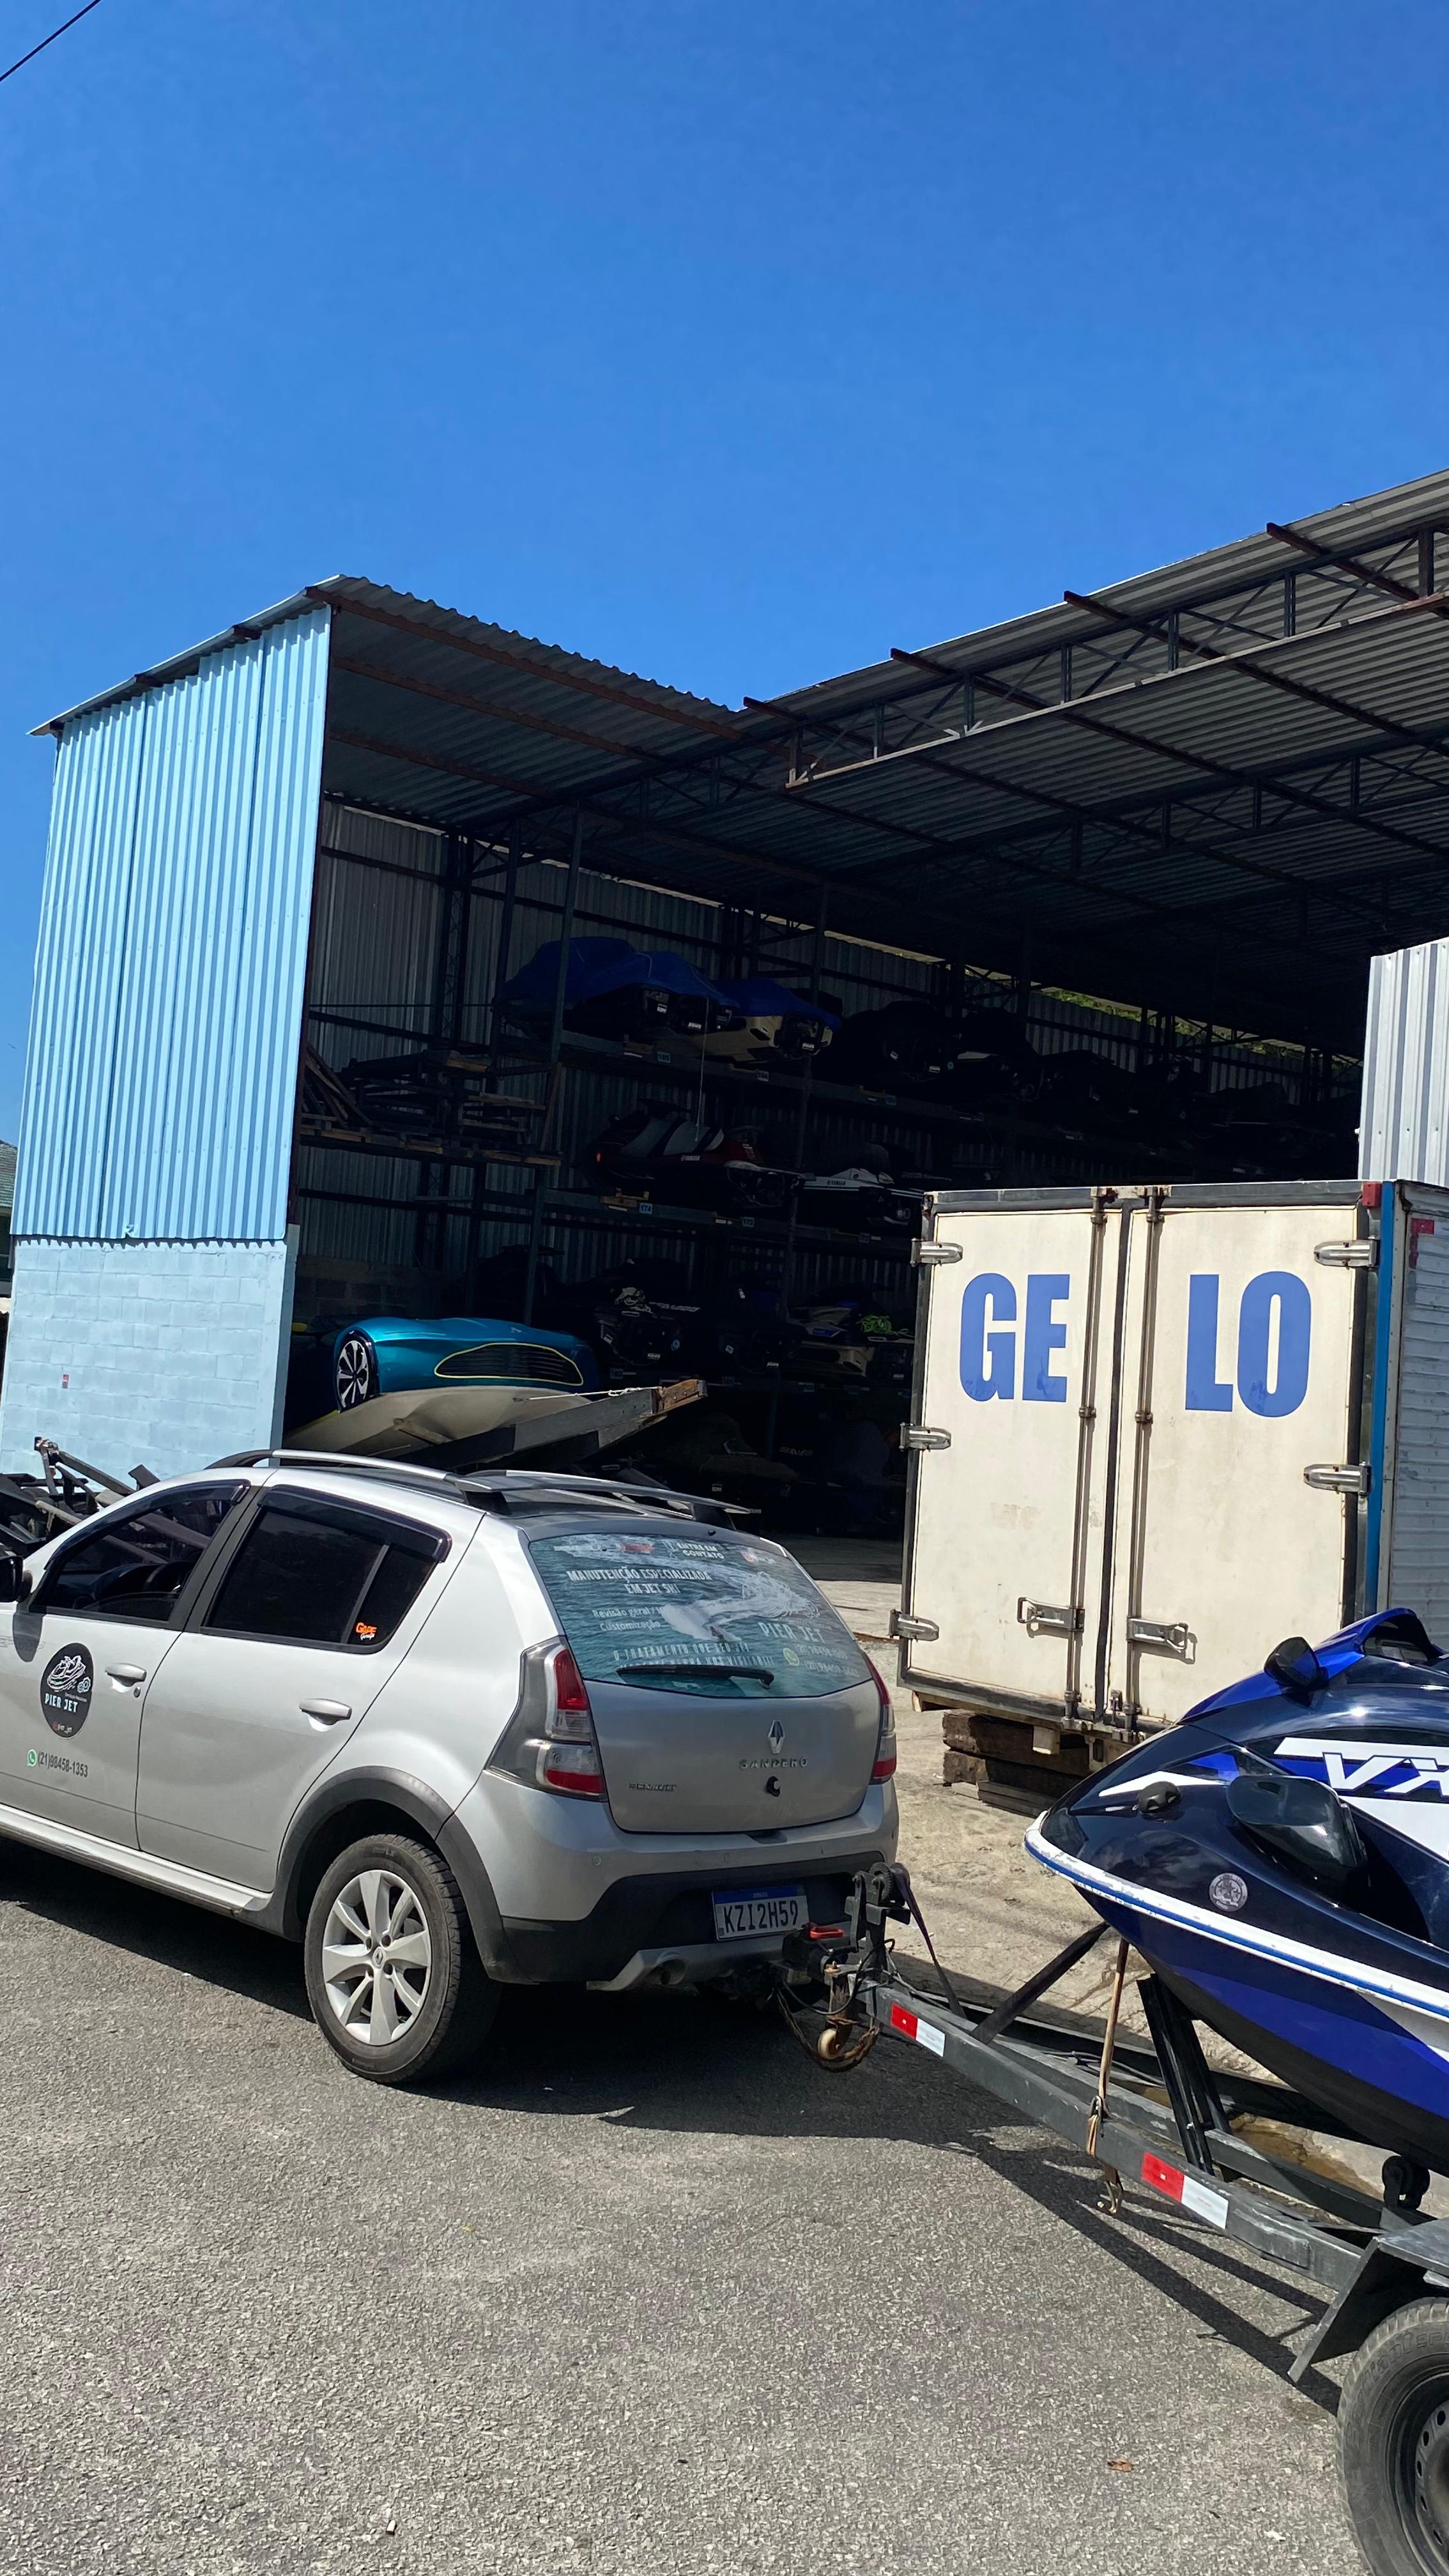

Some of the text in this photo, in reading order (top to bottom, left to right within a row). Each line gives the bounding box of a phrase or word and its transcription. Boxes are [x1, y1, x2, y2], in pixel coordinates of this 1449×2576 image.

[640, 1203, 652, 1213] 174
[682, 1550, 724, 1559] CONTATO
[566, 1566, 713, 1583] MANUTENÇÃO ESPECIALIZADA
[625, 1583, 681, 1594] EM JET SKI
[592, 1608, 627, 1618] Revisão
[628, 1606, 650, 1618] geral
[599, 1619, 661, 1632] Customização
[757, 1621, 798, 1640] PIER
[797, 1625, 825, 1644] JET
[613, 1650, 620, 1661] O
[624, 1644, 689, 1660] TRATAMENTO
[693, 1643, 710, 1654] QUE
[45, 1693, 61, 1708] PIER
[64, 1699, 78, 1713] JET
[38, 1751, 88, 1777] (21)98458-1353
[739, 1757, 808, 1768] SANDERO
[724, 1900, 798, 1933] KZI2H59
